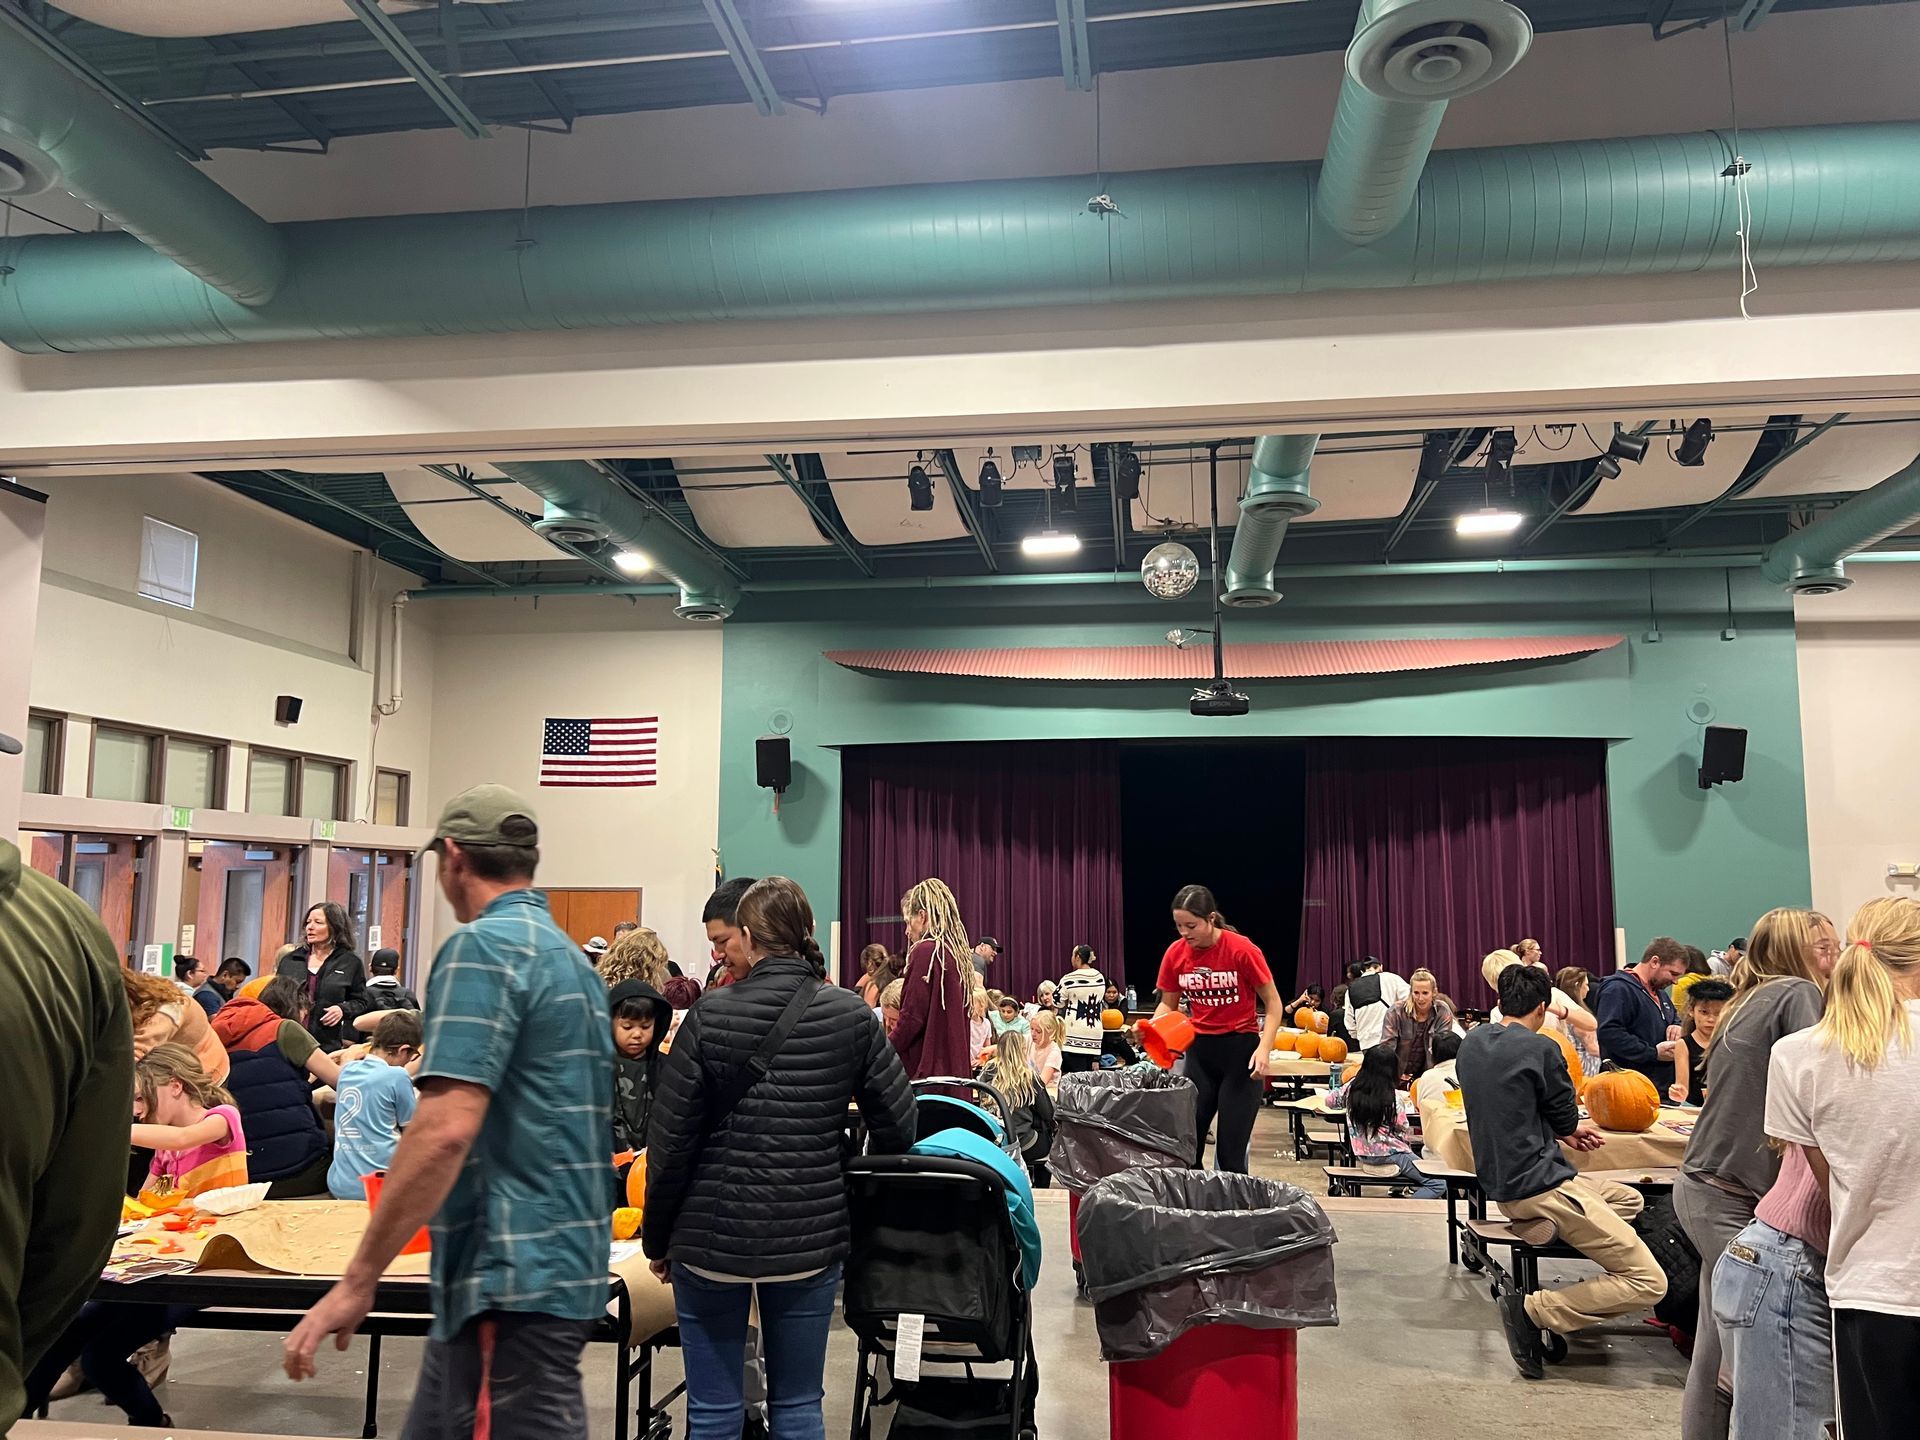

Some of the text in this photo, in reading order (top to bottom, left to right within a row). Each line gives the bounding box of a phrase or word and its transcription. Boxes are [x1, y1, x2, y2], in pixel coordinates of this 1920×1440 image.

[1178, 971, 1238, 989] WESTERN
[1183, 988, 1238, 996] LORADO
[338, 1086, 363, 1139] 2
